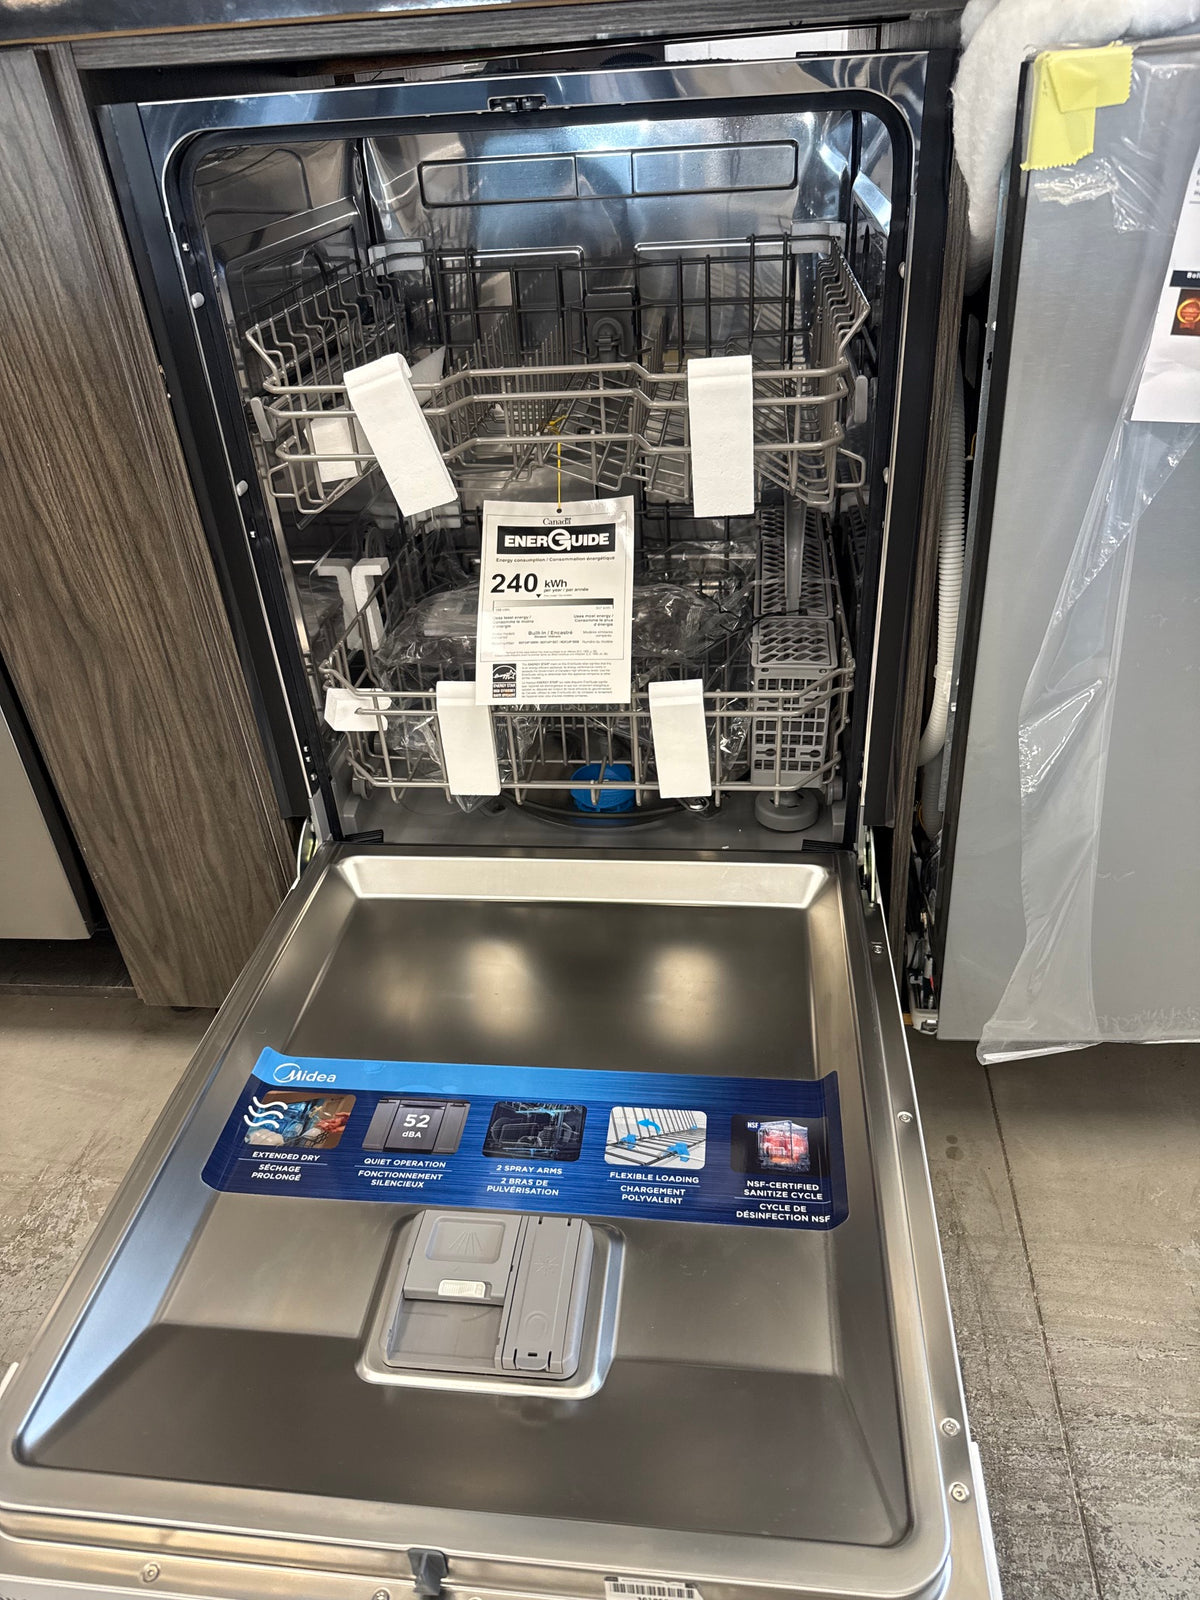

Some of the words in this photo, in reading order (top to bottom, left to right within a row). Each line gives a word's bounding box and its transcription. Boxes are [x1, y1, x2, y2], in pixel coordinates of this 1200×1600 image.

[542, 517, 571, 525] Canada
[504, 528, 610, 551] ENERGUIDE
[490, 573, 538, 593] 240
[544, 579, 567, 588] kWh
[273, 1063, 337, 1083] Midea
[403, 1114, 431, 1128] 52
[402, 1130, 422, 1138] dBA
[252, 1151, 300, 1160] EXTENDED
[300, 1154, 321, 1162] DRY
[258, 1163, 302, 1173] SÉCHAGE
[363, 1157, 392, 1166] QUIET
[393, 1159, 446, 1168] OPERATION
[357, 1169, 444, 1181] FONCTIONNEMENT
[503, 1165, 535, 1173] SPRAY
[536, 1167, 563, 1175] ARMS
[251, 1171, 302, 1181] PROLONGÉ
[609, 1171, 654, 1181] FLEXIBLE
[655, 1174, 700, 1184] LOADING
[370, 1179, 425, 1189] SILENCIEUX
[508, 1178, 534, 1186] BRAS
[535, 1179, 549, 1187] DE
[746, 1180, 820, 1191] NSF-CERTIFIED
[486, 1184, 559, 1196] PULVÉRISATION
[620, 1185, 686, 1196] CHARGEMENT
[743, 1189, 789, 1198] SANITIZE
[790, 1191, 824, 1200] CYCLE
[621, 1193, 683, 1205] POLYVALENT
[759, 1203, 791, 1212] CYCLE
[793, 1204, 807, 1213] DE
[736, 1210, 809, 1221] DÉSINFECTION
[811, 1215, 831, 1223] NSF
